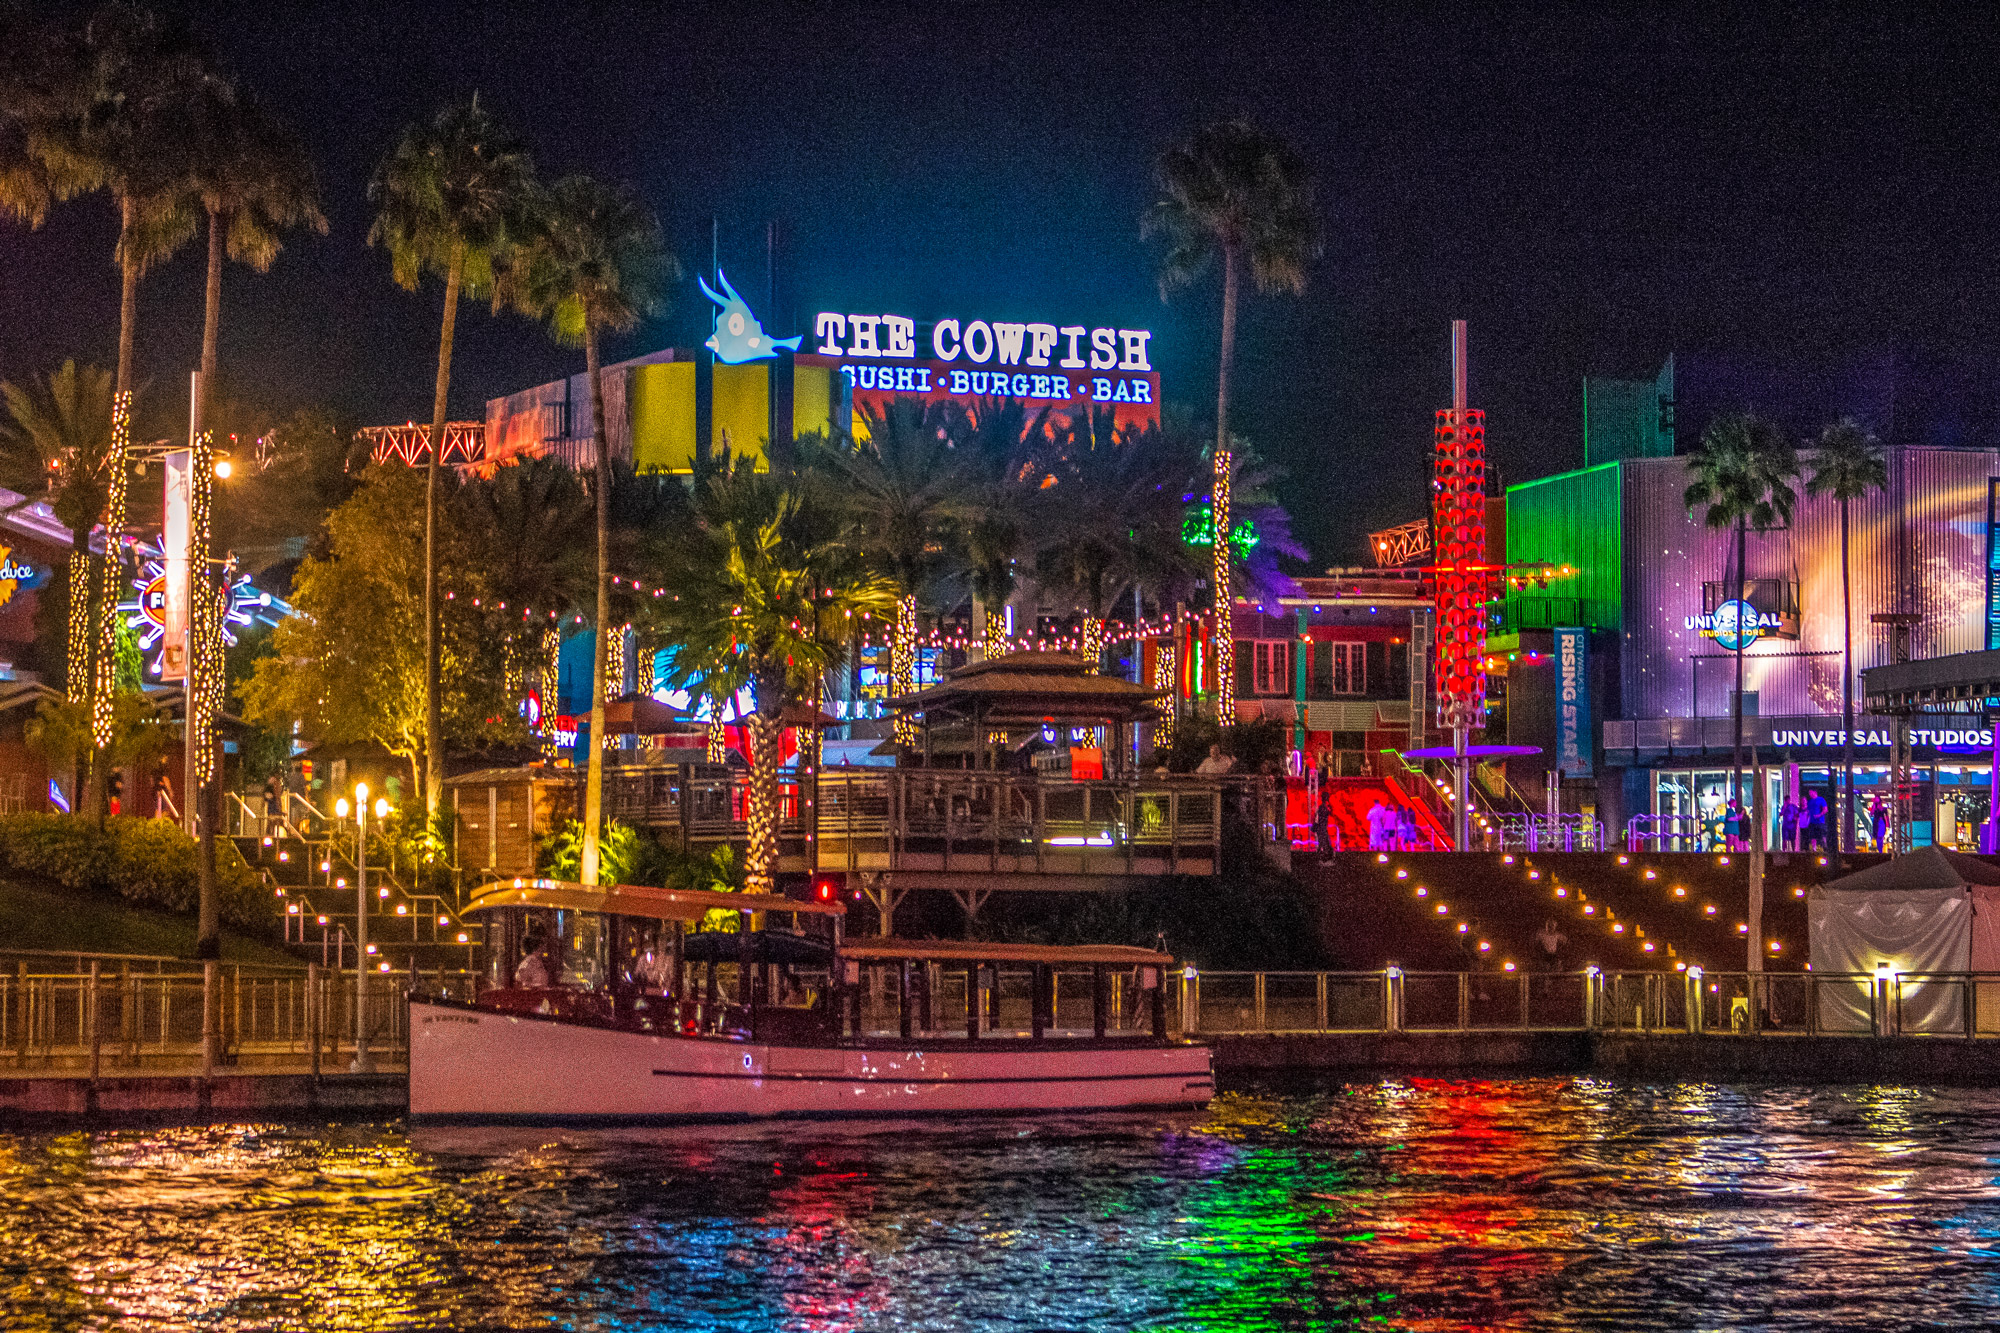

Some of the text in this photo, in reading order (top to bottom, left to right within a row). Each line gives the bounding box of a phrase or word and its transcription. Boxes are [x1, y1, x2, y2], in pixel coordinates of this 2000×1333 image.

[815, 311, 1152, 371] THE COWFISH
[840, 364, 1153, 403] SUSHI BURGER BAR
[1684, 612, 1783, 630] UNIVERSAL
[1699, 628, 1766, 638] STUDIOS TORE
[1561, 634, 1577, 702] RISING
[1562, 703, 1579, 758] STAR
[1772, 729, 1994, 747] UNIVERSAL STUDIOS
